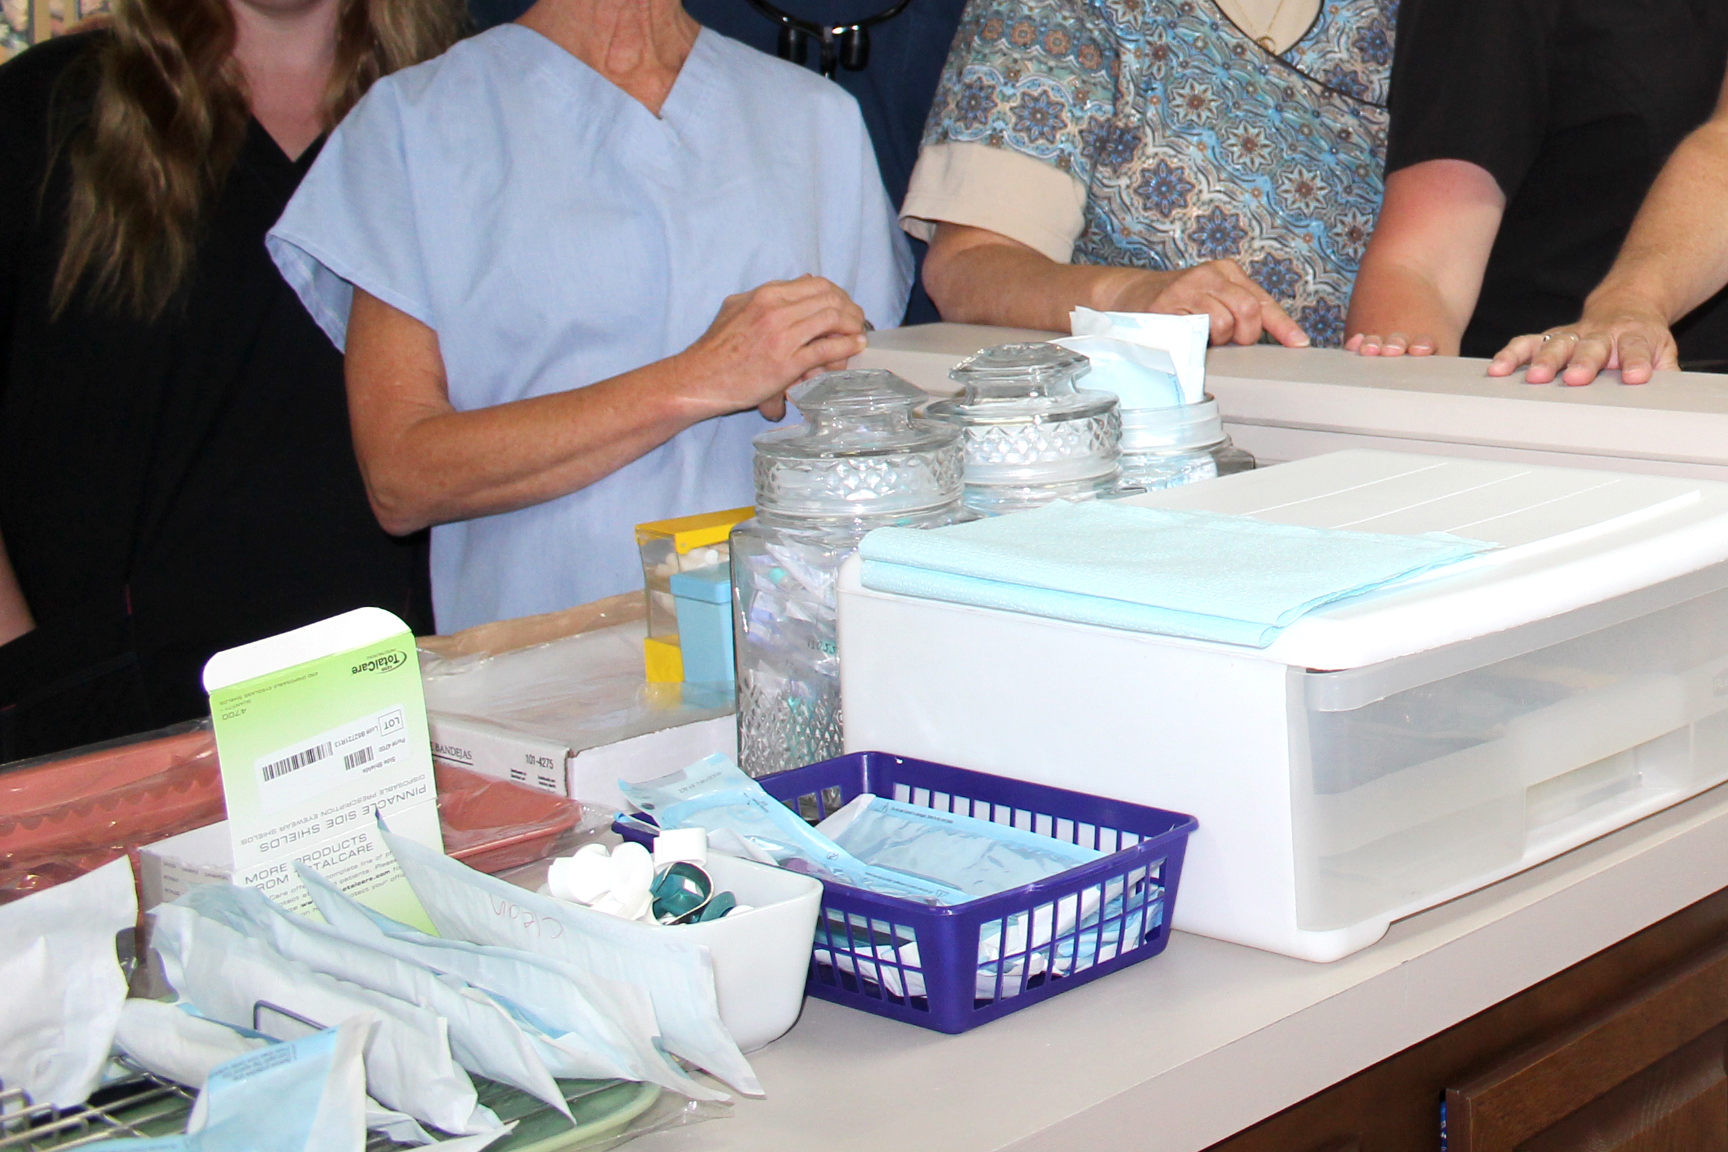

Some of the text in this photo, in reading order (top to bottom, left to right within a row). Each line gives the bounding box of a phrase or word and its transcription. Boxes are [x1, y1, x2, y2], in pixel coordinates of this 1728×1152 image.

[351, 653, 400, 675] TotalCare
[222, 708, 247, 720] 4700
[384, 716, 400, 730] LOT
[435, 743, 473, 760] BANDEJAS
[525, 754, 554, 769] 101-4275
[241, 774, 426, 845] DISPOSABLE PRESCRIPTION EYEWEAR SHIELDS
[260, 784, 427, 853] PINNACLE SIDE SHIELDS
[245, 862, 288, 885] MORE
[255, 874, 289, 891] ROM
